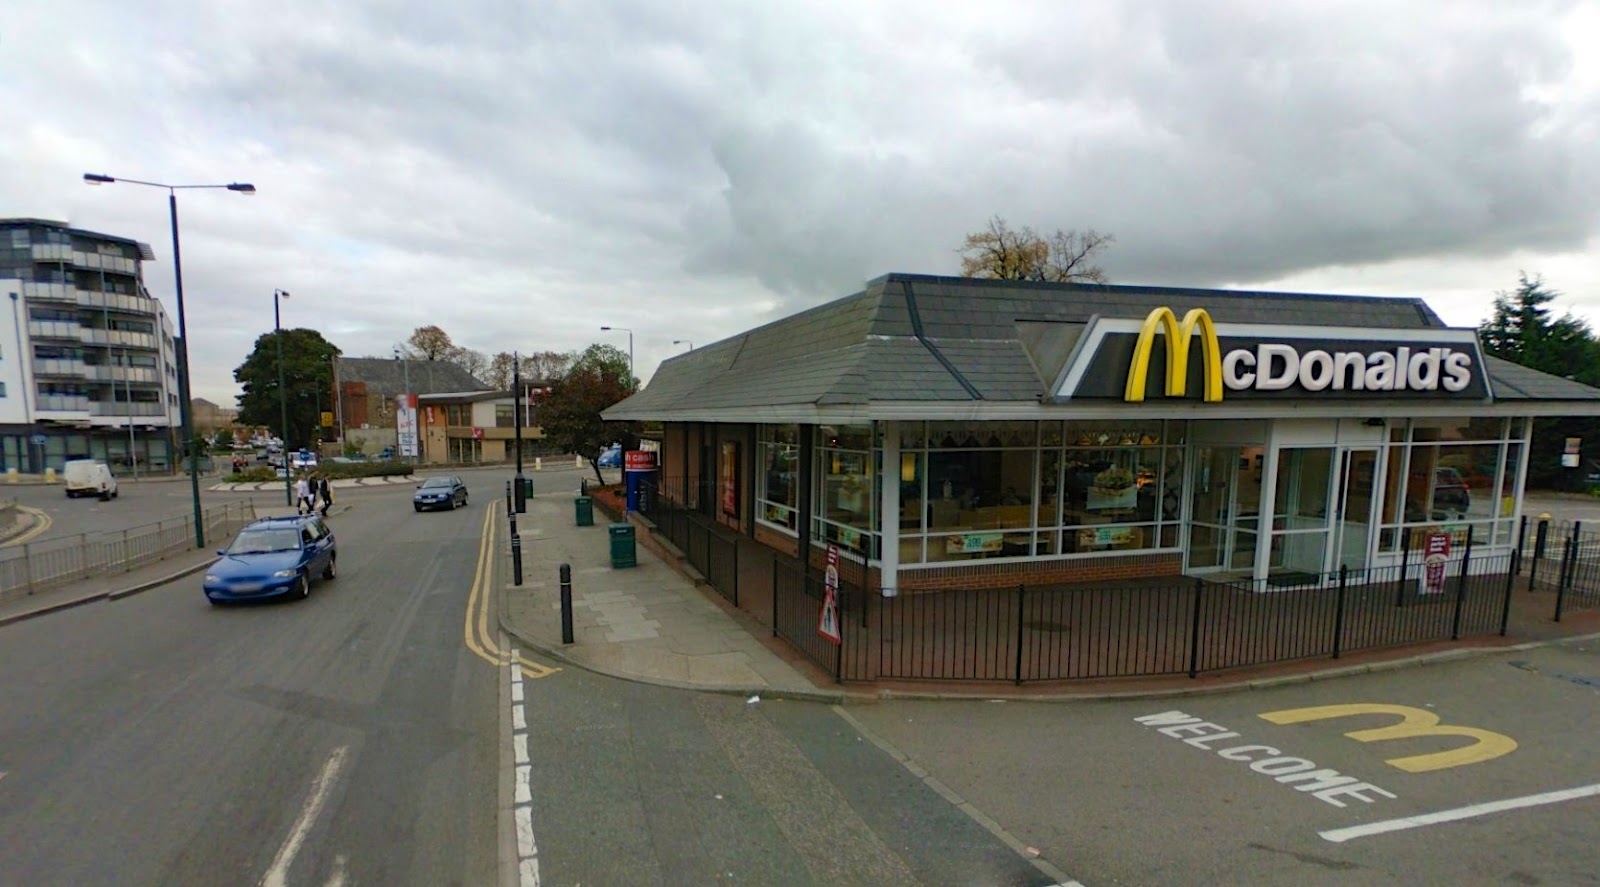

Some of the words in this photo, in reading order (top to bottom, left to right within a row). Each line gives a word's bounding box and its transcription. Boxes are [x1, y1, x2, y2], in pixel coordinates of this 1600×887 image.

[1124, 306, 1472, 402] McDonald's
[632, 452, 655, 462] cash
[1133, 710, 1398, 808] WELCOME
